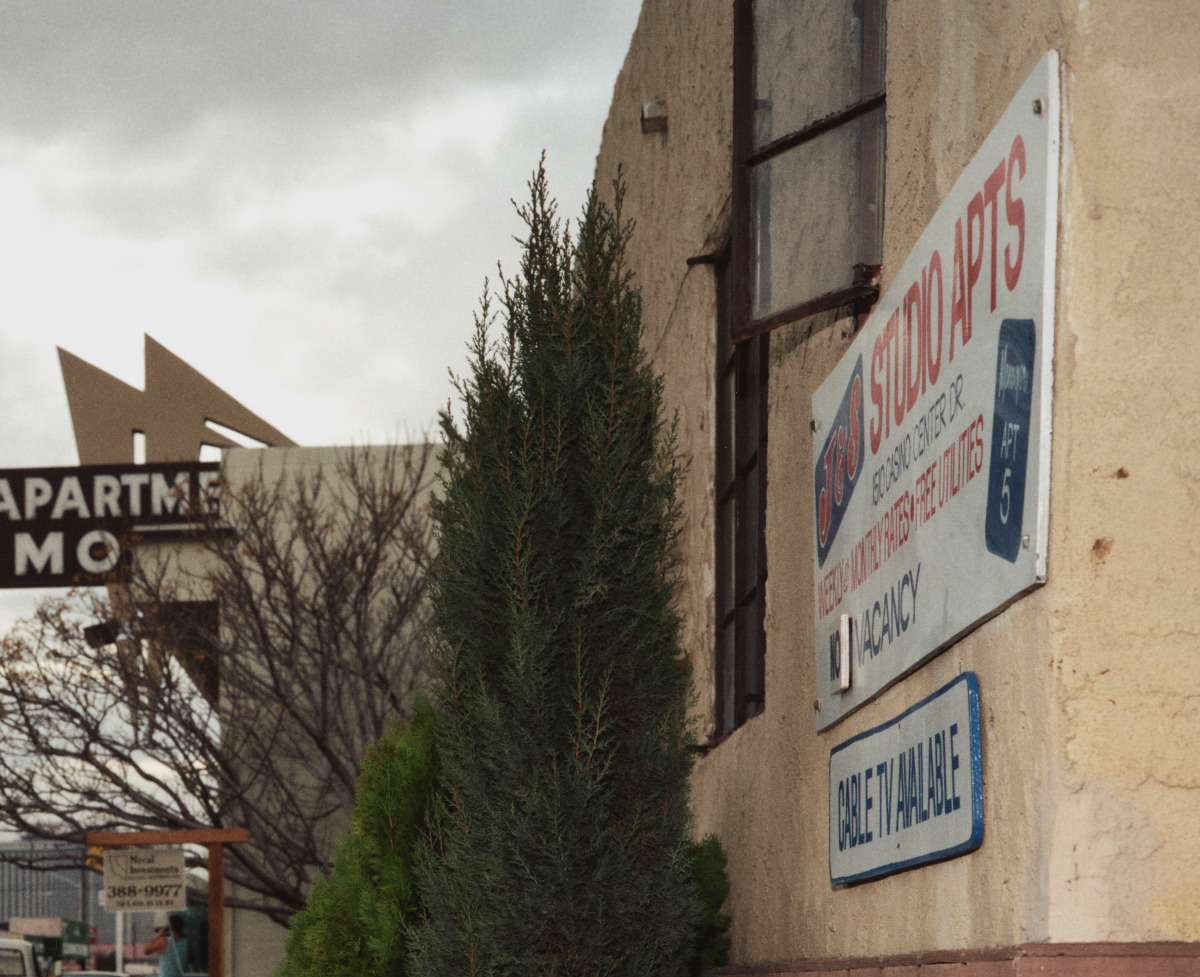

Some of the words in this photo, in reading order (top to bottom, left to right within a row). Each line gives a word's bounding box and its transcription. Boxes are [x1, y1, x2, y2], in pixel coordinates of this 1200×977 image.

[870, 250, 944, 455] STUDIO
[949, 134, 1027, 365] APTS
[885, 433, 912, 491] CASINO
[913, 393, 947, 462] CENTER
[1000, 421, 1020, 462] APT
[818, 558, 844, 620] WEEKLY
[851, 511, 884, 593] MONTHLY
[884, 489, 910, 552] RATES
[914, 460, 938, 531] FREE
[938, 413, 984, 509] UTILITIES
[999, 468, 1011, 525] 5
[14, 529, 121, 577] MO
[854, 562, 922, 667] VACANCY
[838, 767, 873, 853] CABLE
[877, 757, 894, 839] TV
[895, 722, 961, 832] AVAILABLE
